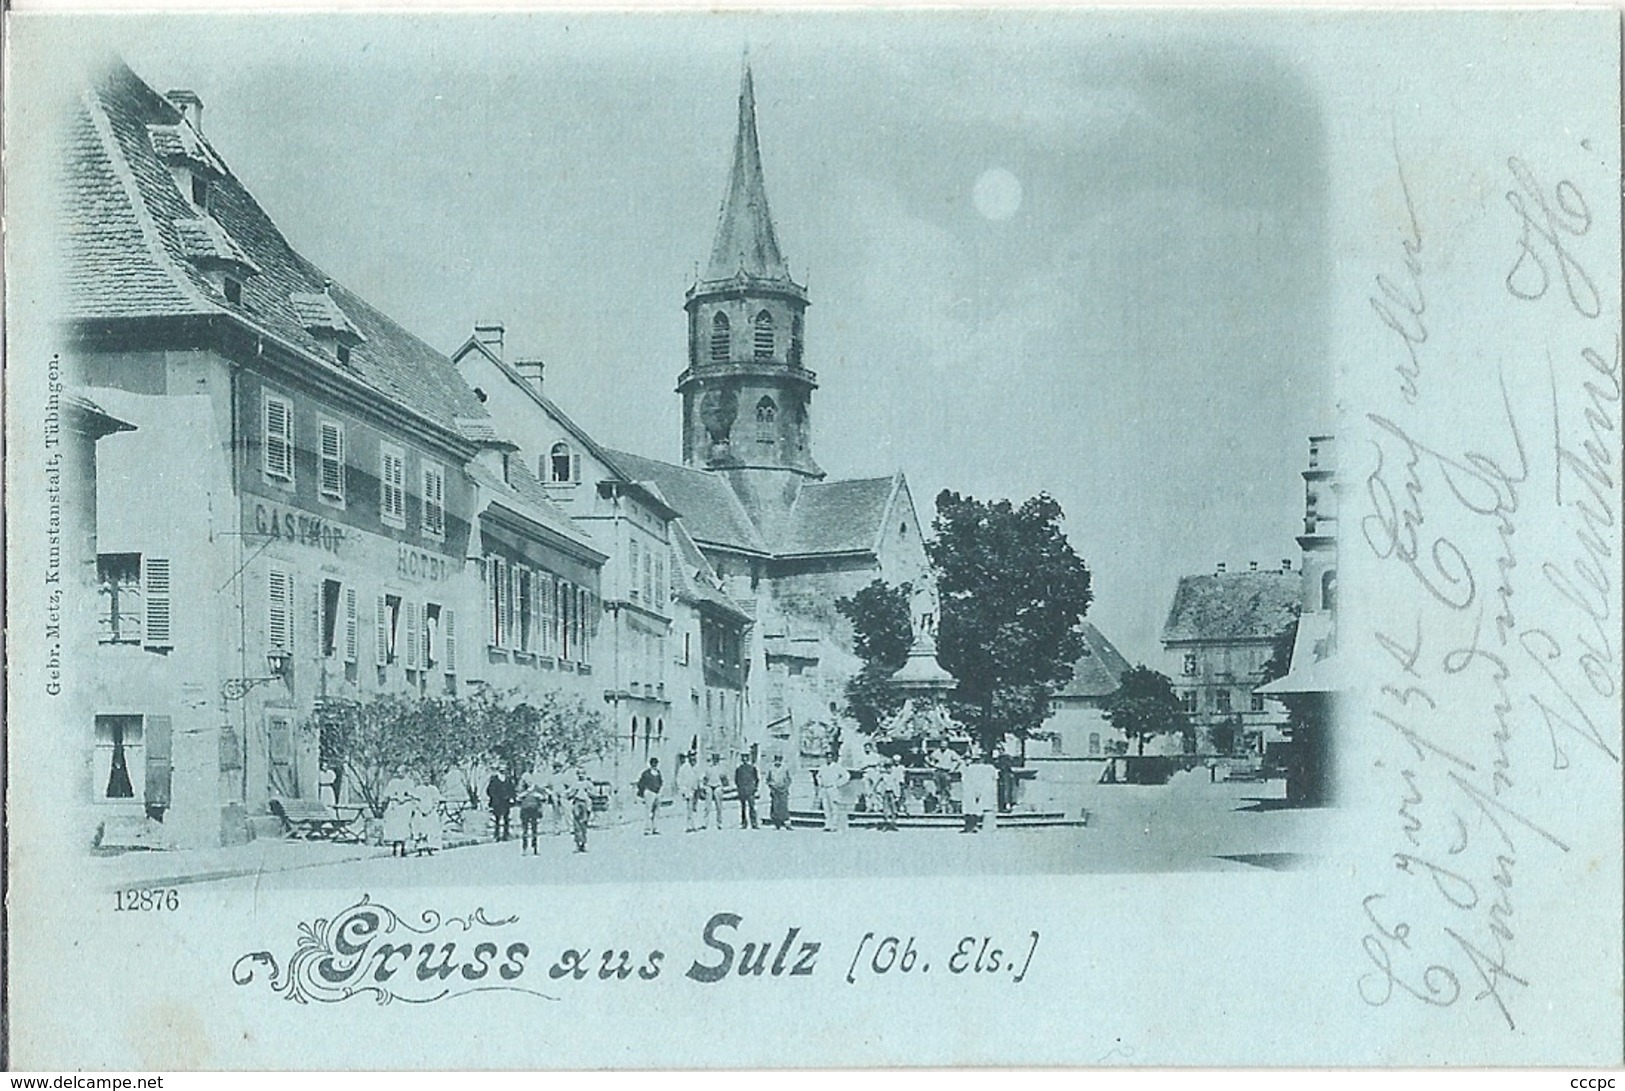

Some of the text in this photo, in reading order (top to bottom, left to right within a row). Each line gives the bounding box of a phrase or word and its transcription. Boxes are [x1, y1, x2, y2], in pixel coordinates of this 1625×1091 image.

[45, 353, 63, 697] Gebr. Metz, Kunstanstalt, Tübingen.
[254, 501, 344, 555] GASTHOF
[113, 889, 180, 912] 12876
[317, 910, 530, 983] Gruss
[548, 947, 666, 981] aus
[685, 912, 822, 983] Sulz
